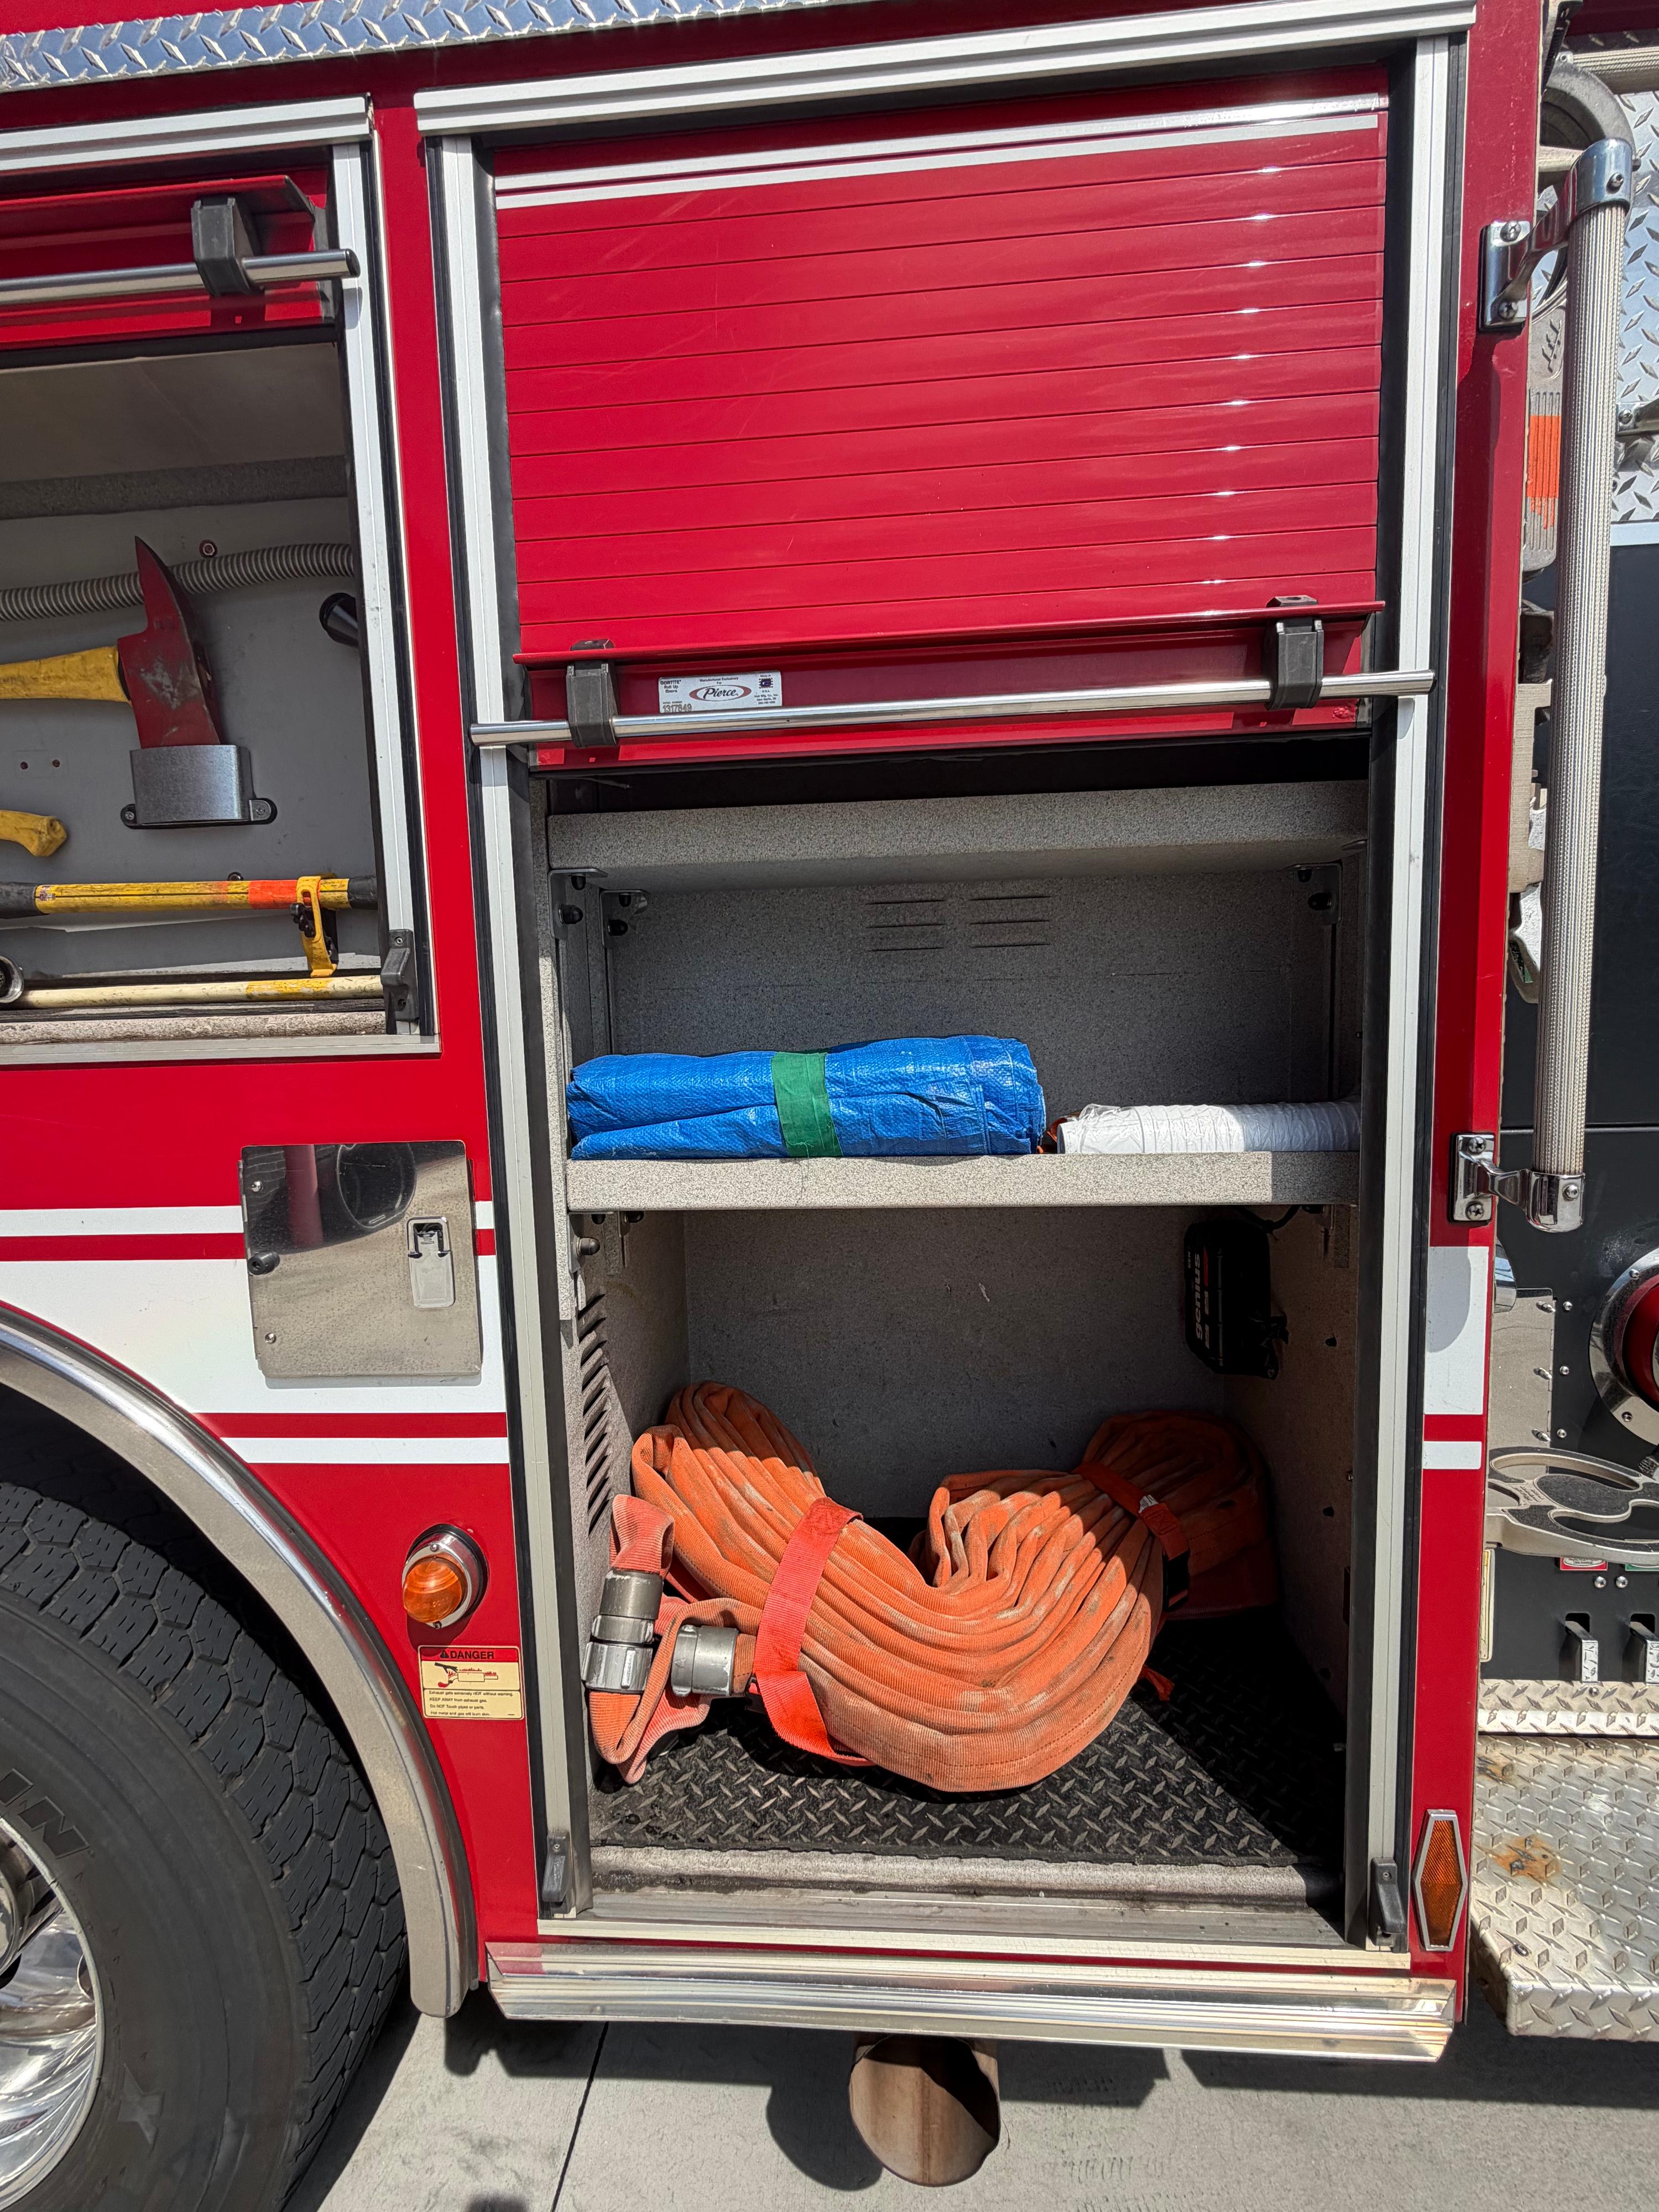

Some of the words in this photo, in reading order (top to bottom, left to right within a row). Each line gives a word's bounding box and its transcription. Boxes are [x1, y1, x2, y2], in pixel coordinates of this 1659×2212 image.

[703, 688, 737, 699] Pierce
[663, 703, 692, 713] 1317849
[450, 1651, 494, 1660] DANGER
